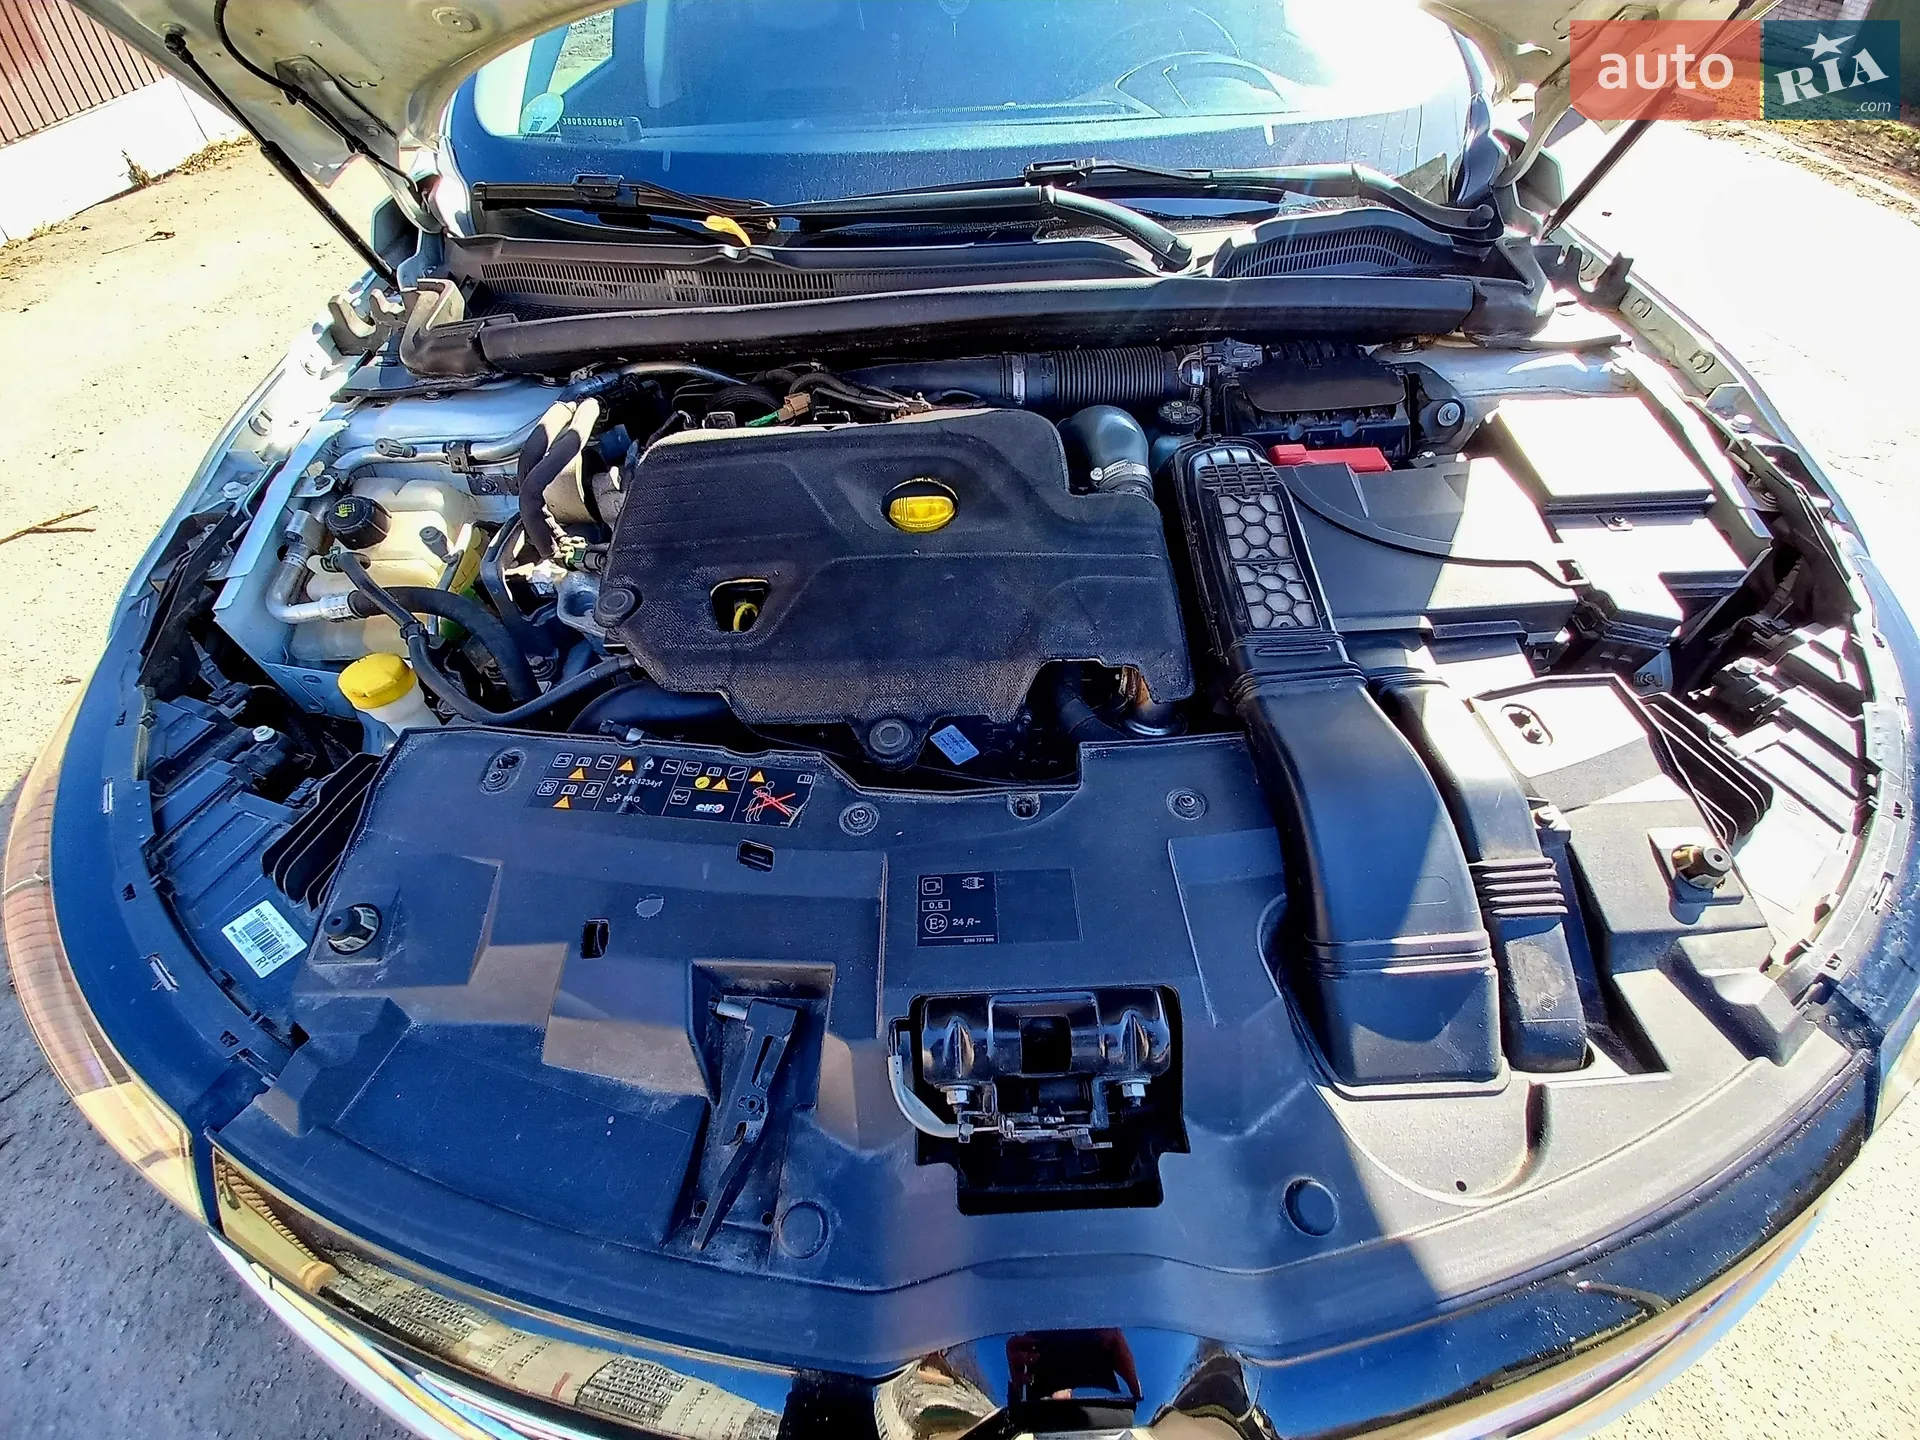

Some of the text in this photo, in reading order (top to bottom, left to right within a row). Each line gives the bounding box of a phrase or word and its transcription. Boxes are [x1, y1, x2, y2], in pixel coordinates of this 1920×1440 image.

[929, 902, 944, 910] 0,5
[929, 918, 945, 930] E2
[952, 918, 964, 926] 24
